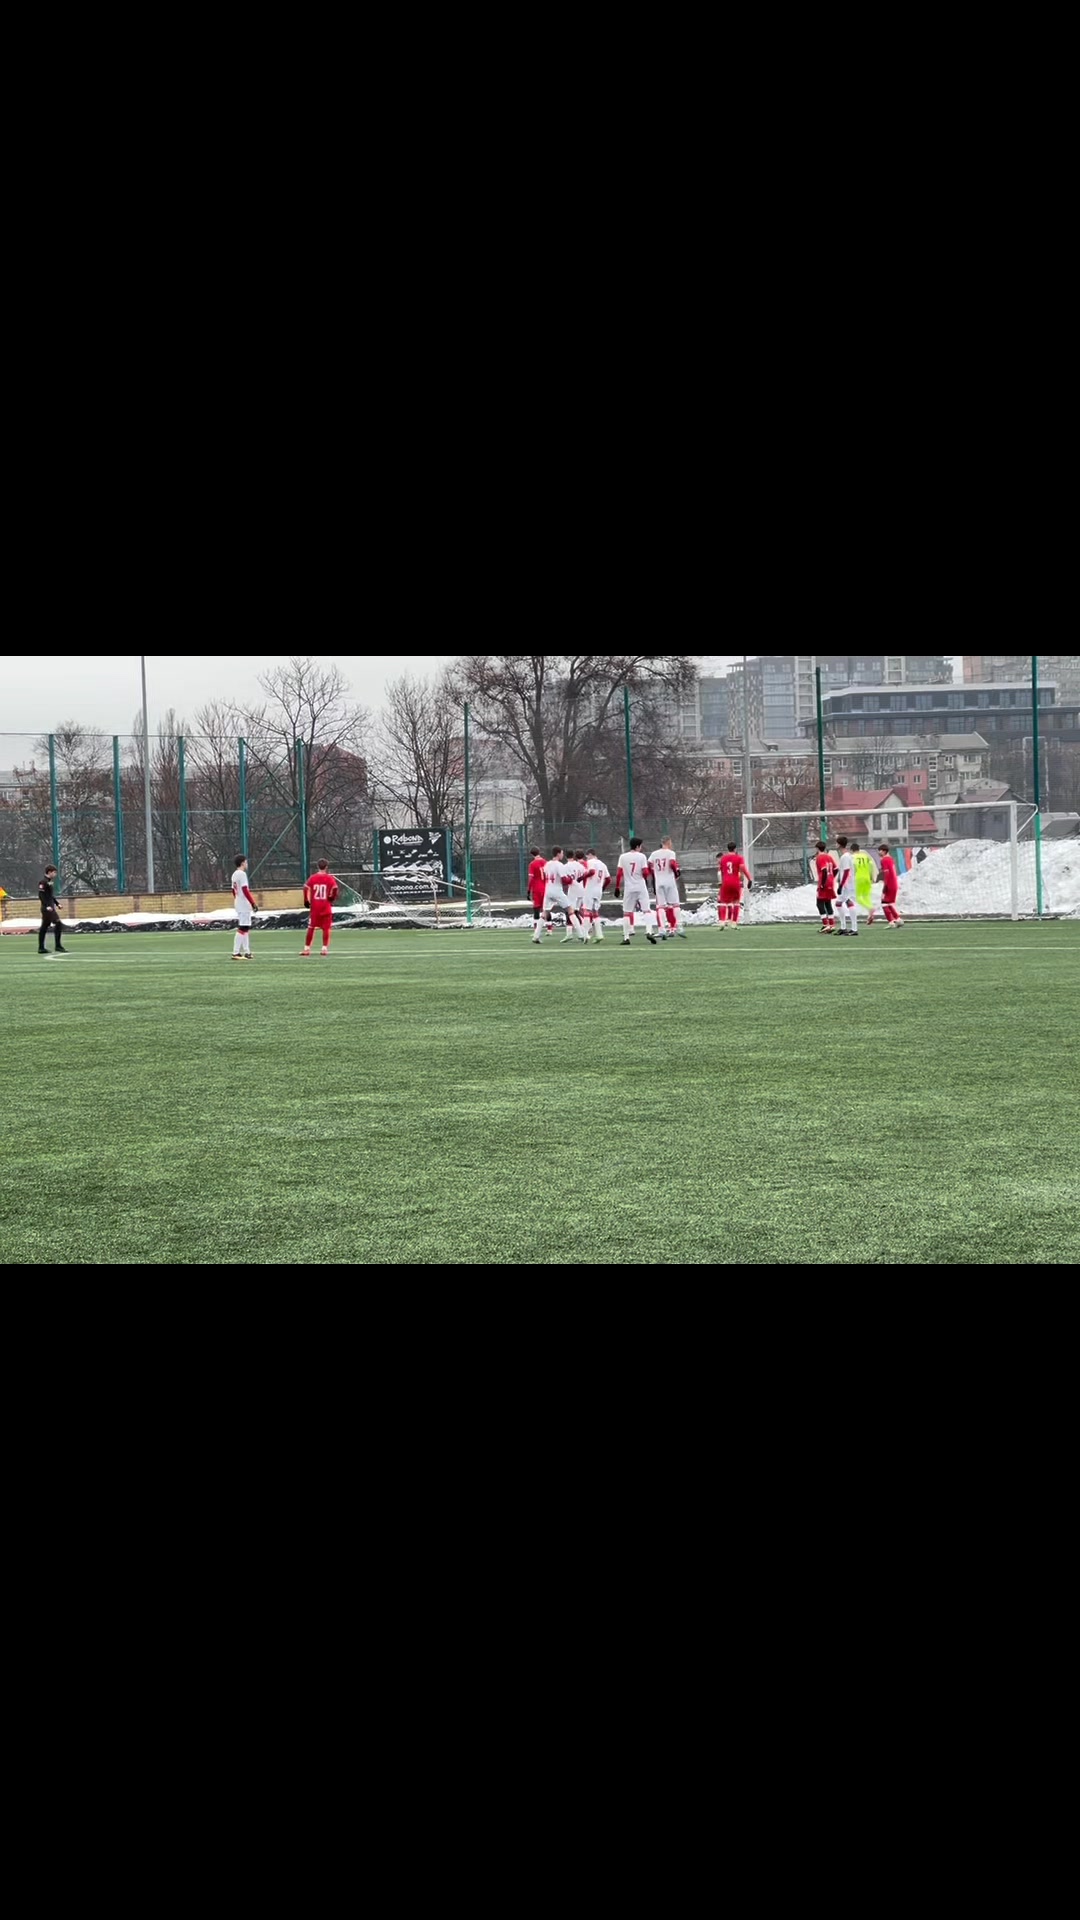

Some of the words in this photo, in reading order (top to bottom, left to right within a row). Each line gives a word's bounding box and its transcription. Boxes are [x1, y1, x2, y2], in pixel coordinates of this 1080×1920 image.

[629, 862, 636, 876] 7
[726, 861, 733, 874] 3
[598, 869, 604, 883] 9
[313, 884, 327, 900] 20
